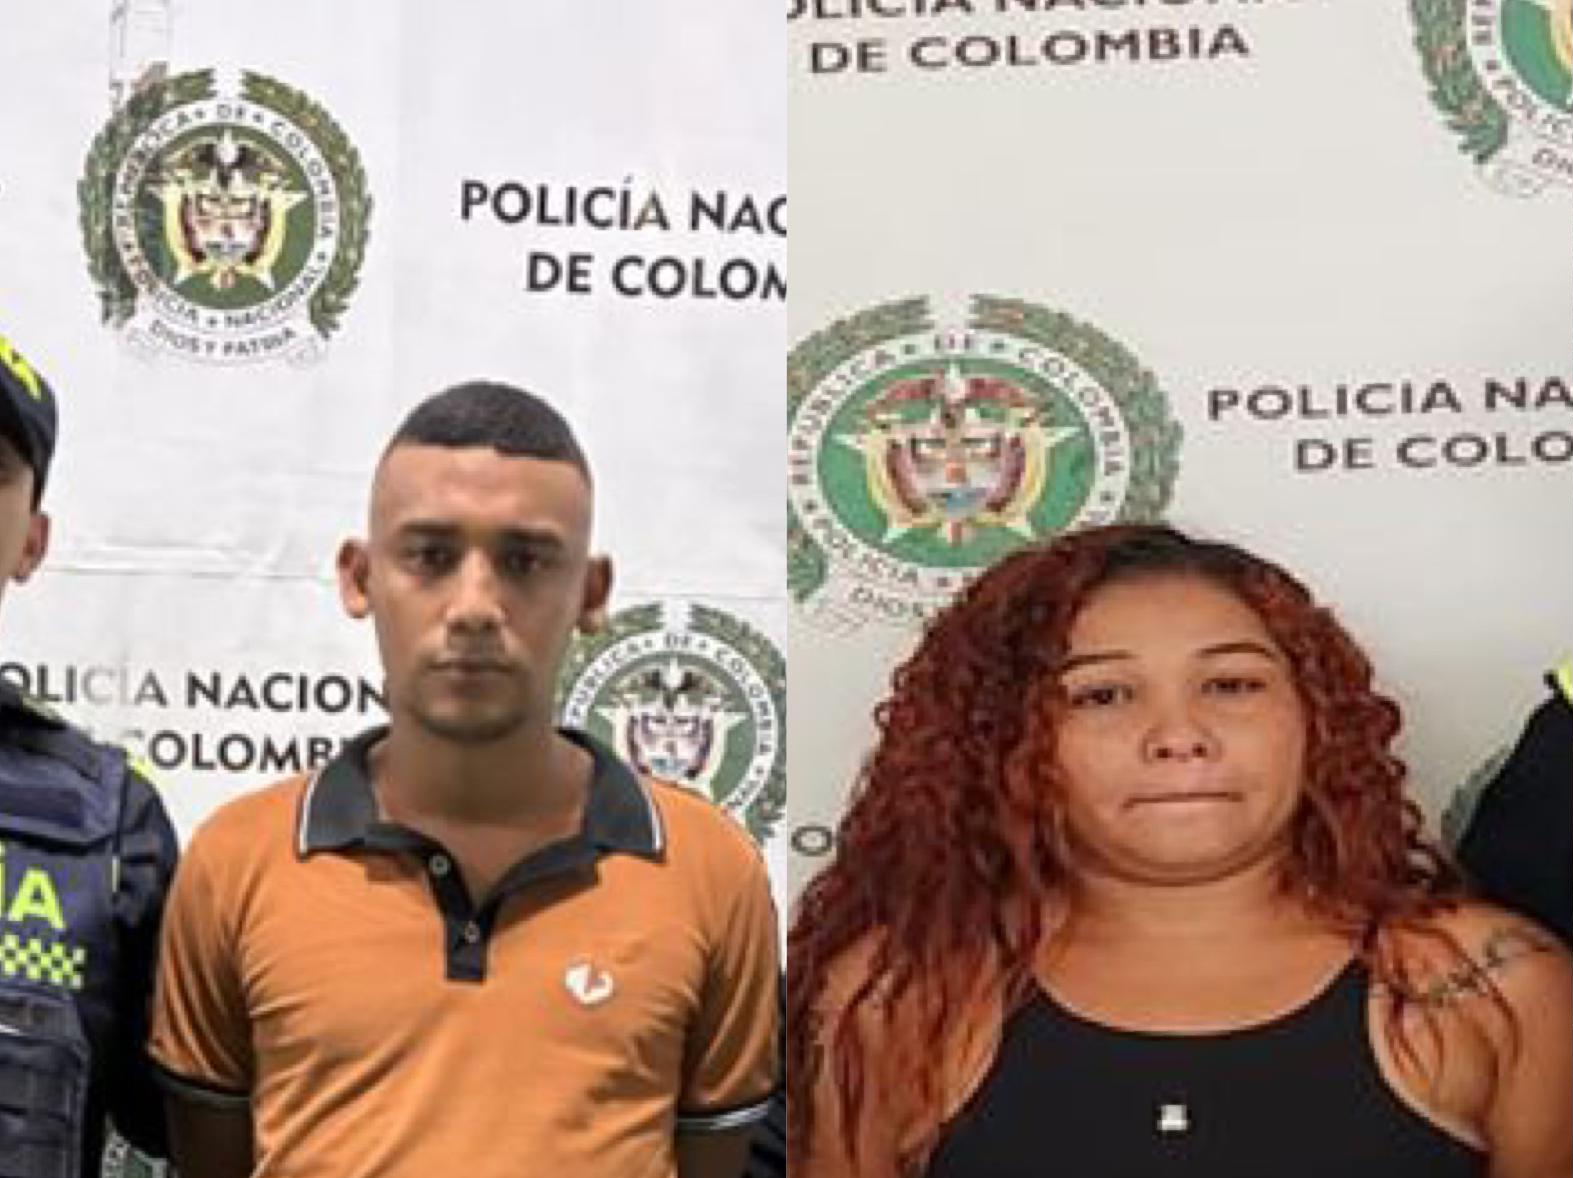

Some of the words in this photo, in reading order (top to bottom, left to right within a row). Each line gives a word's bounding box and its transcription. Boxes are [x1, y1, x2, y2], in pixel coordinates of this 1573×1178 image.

[811, 42, 887, 74] DE
[910, 24, 1249, 68] COLOMBIA
[461, 174, 671, 230] POLICÍA
[527, 252, 592, 292] DE
[1208, 381, 1462, 421] POLICIA
[1296, 437, 1373, 472] DE
